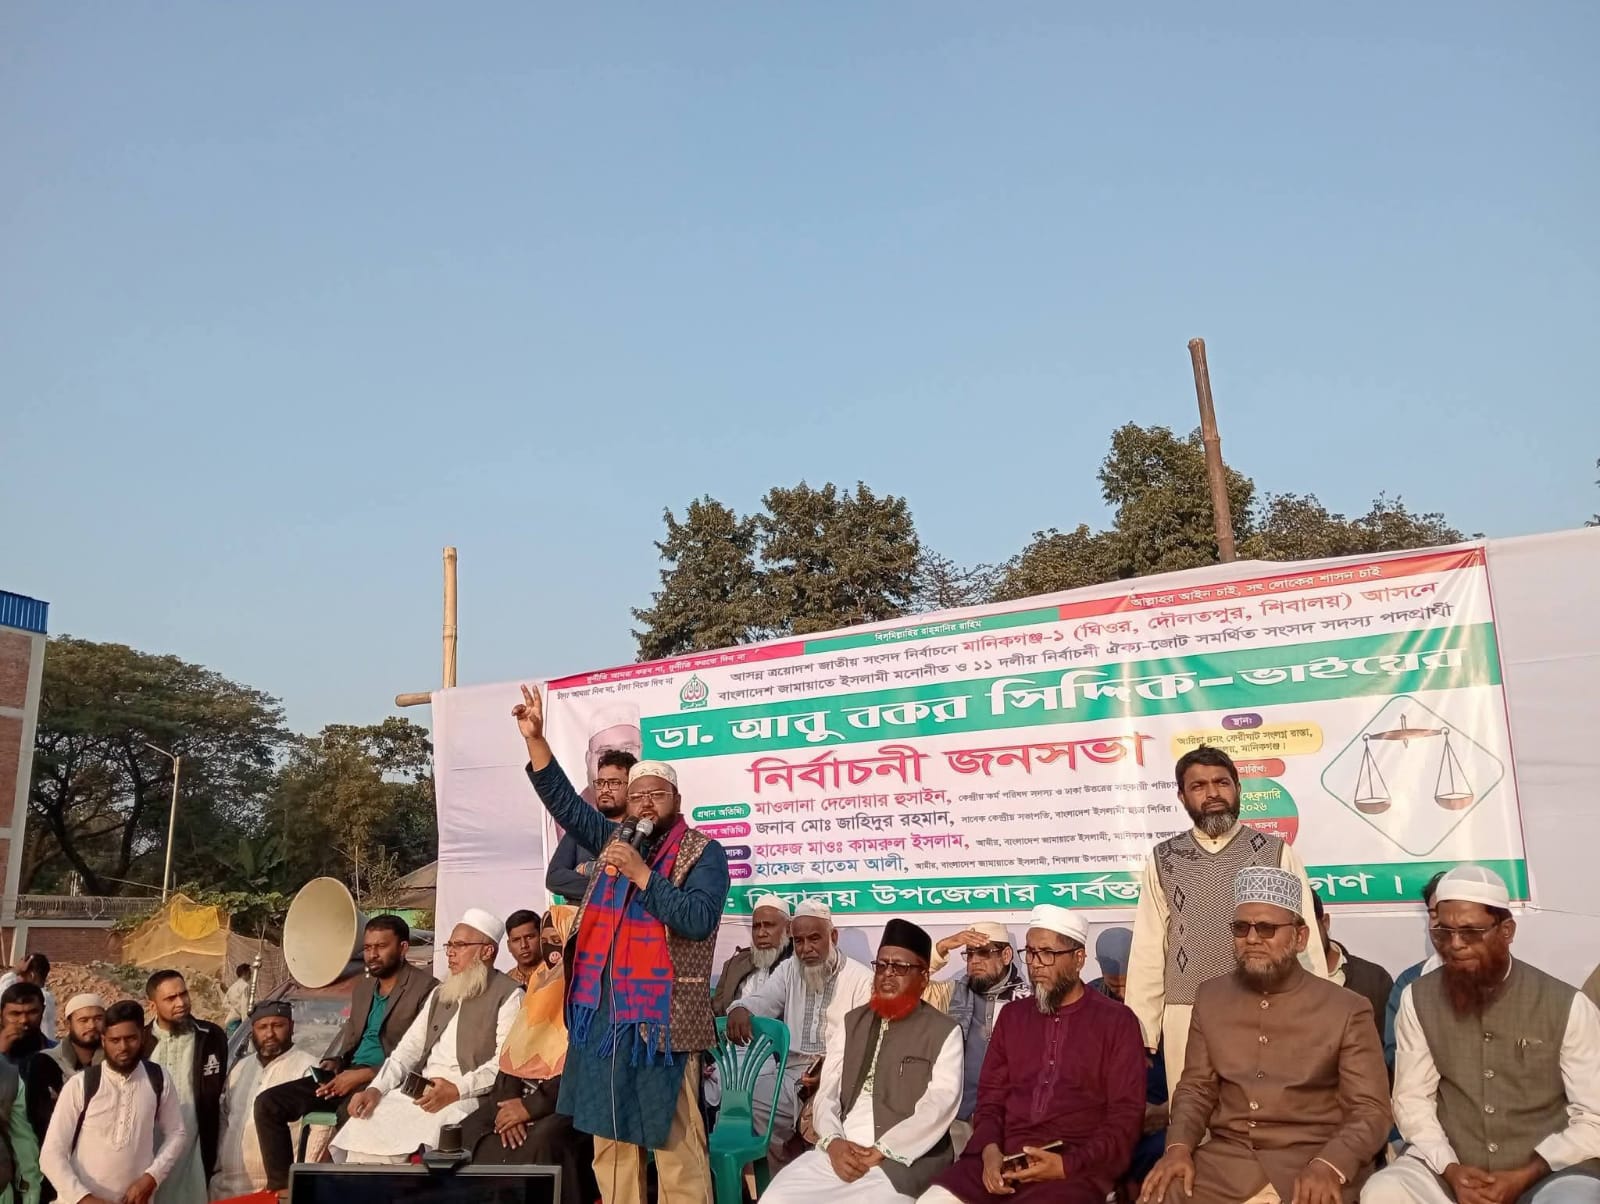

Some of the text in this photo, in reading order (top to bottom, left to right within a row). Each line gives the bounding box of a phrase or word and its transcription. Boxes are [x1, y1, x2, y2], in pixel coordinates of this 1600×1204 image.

[1178, 590, 1212, 601] আইন
[1216, 586, 1241, 597] চাই,
[1247, 582, 1264, 592] সৎ
[1269, 576, 1314, 590] লোকের
[1320, 570, 1354, 583] শাসন
[1358, 566, 1381, 577] চাই
[730, 582, 1438, 682] আসন্ন ত্রয়োদশ জাতীয় সংসদ নির্বাচনে মানিকগঞ্জ-১ (ঘিওর, দৌলতপুর, শিবালয়) আসনে
[718, 686, 774, 702] বাংলাদেশ
[778, 678, 838, 694] জামায়াতে
[839, 670, 890, 686] ইসলামী
[894, 661, 950, 680] মনোনীত
[956, 662, 967, 672] ও
[974, 659, 992, 671] ১১
[998, 652, 1038, 668] দলীয়
[1042, 643, 1100, 664] নির্বাচনী
[1106, 634, 1190, 654] ঐক্য-জোট
[1196, 626, 1258, 646] সমর্থিত
[1262, 622, 1316, 638] সংসদ
[1322, 614, 1374, 631] সদস্য
[1380, 602, 1454, 624] পদপ্রার্থী
[650, 724, 714, 749] ডা.
[728, 710, 846, 742] আবু
[840, 695, 973, 728] বকর
[746, 732, 1156, 794] নির্বাচনী জনসভা
[754, 798, 816, 815] মাওলানা
[821, 794, 889, 812] দেলোয়ার
[894, 788, 952, 808] হুসাইন,
[1151, 780, 1179, 790] পরিচা
[755, 820, 796, 836] জনাব
[801, 818, 830, 833] মোঃ
[836, 812, 894, 832] জাহিদুর
[899, 810, 955, 827] রহমান,
[1056, 810, 1090, 819] বাংলাদেশ
[1092, 805, 1124, 816] ইসলামী
[1147, 804, 1172, 814] শিবির
[754, 842, 803, 858] হাফেজ
[807, 840, 843, 854] মাওঃ
[848, 838, 906, 852] কামরুল
[910, 832, 970, 851] ইসলাম,
[1004, 838, 1039, 846] বাংলাদেশ
[755, 862, 806, 877] হাফেজ
[811, 859, 859, 876] হাতেম
[864, 853, 908, 873] আলী,
[941, 860, 975, 869] বাংলাদেশ
[868, 882, 1039, 906] উপজেলার
[1048, 874, 1142, 902] সর্বস্ত
[1308, 872, 1376, 897] গণ
